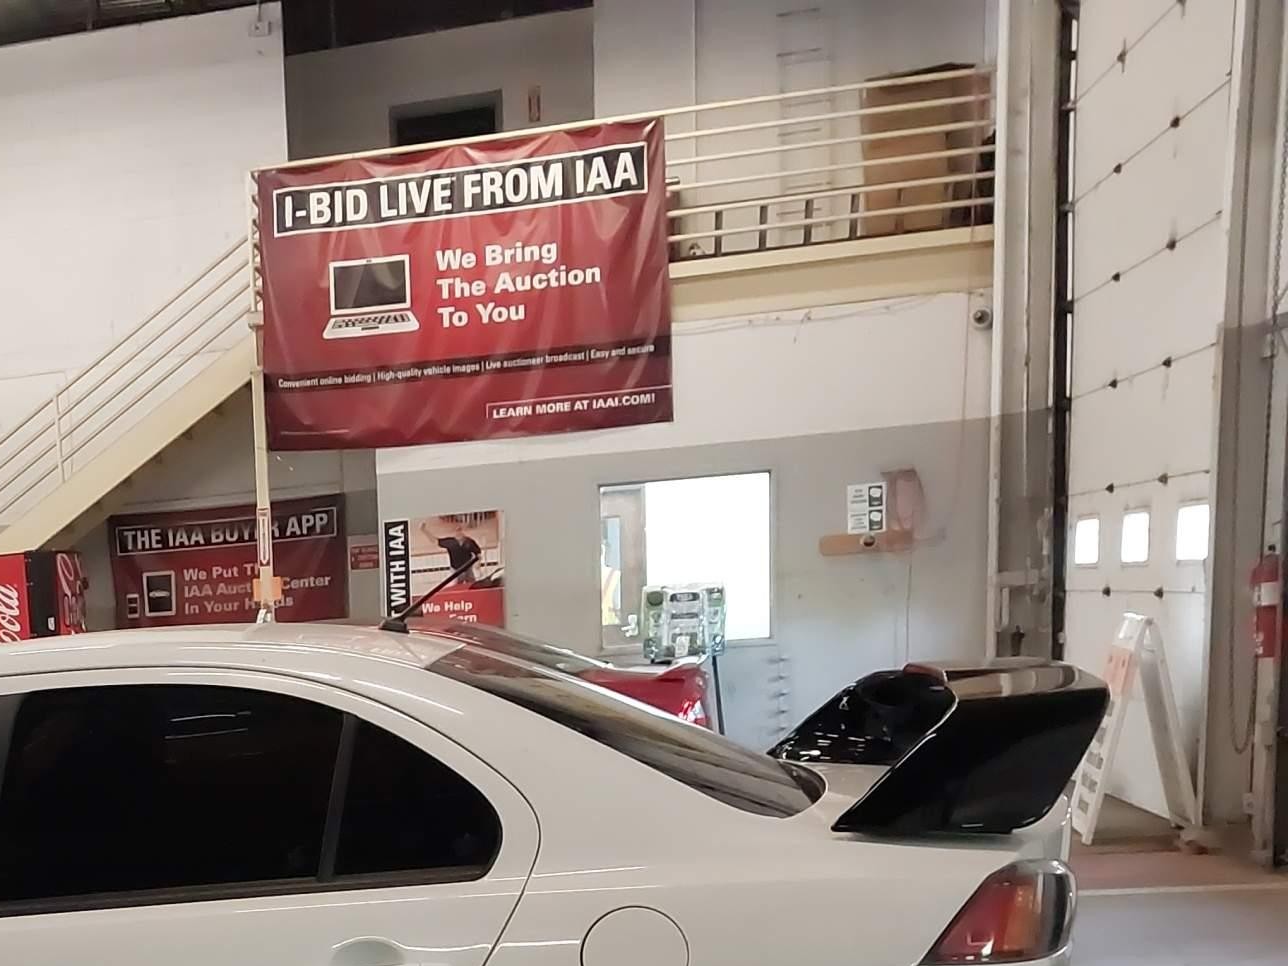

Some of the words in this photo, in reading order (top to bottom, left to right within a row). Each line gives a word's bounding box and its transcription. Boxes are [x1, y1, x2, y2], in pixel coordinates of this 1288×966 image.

[284, 188, 368, 227] I-BID
[379, 178, 453, 218] LIVE
[463, 163, 563, 209] FROM
[575, 151, 638, 194] IAA
[435, 248, 477, 271] We
[484, 241, 558, 266] Bring
[435, 278, 486, 299] The
[494, 265, 601, 294] Auction
[437, 306, 469, 328] To
[475, 302, 525, 324] You
[278, 378, 318, 388] Convenient
[319, 376, 342, 386] online
[344, 374, 371, 384] bidding
[377, 369, 422, 382] High-quality
[423, 366, 451, 376] vehicle
[452, 363, 480, 375] images
[485, 358, 502, 370] Live
[503, 355, 544, 368] auctioneer
[545, 351, 585, 362] broadcast
[590, 348, 610, 360] Easy
[611, 346, 626, 356] and
[492, 405, 533, 419] LEARN
[535, 401, 572, 415] MORE
[573, 400, 590, 411] AT
[123, 528, 163, 550] THE
[168, 526, 205, 547] IAA
[211, 519, 281, 543] BUYR
[285, 512, 329, 537] APP
[388, 524, 405, 556] IAA
[183, 568, 207, 581] We
[212, 565, 239, 579] Put
[183, 583, 213, 598] IAA
[281, 575, 332, 590] Center
[390, 560, 407, 607] WITH
[184, 601, 200, 614] In
[203, 599, 239, 613] Your
[421, 603, 441, 614] We
[444, 600, 473, 612] Help
